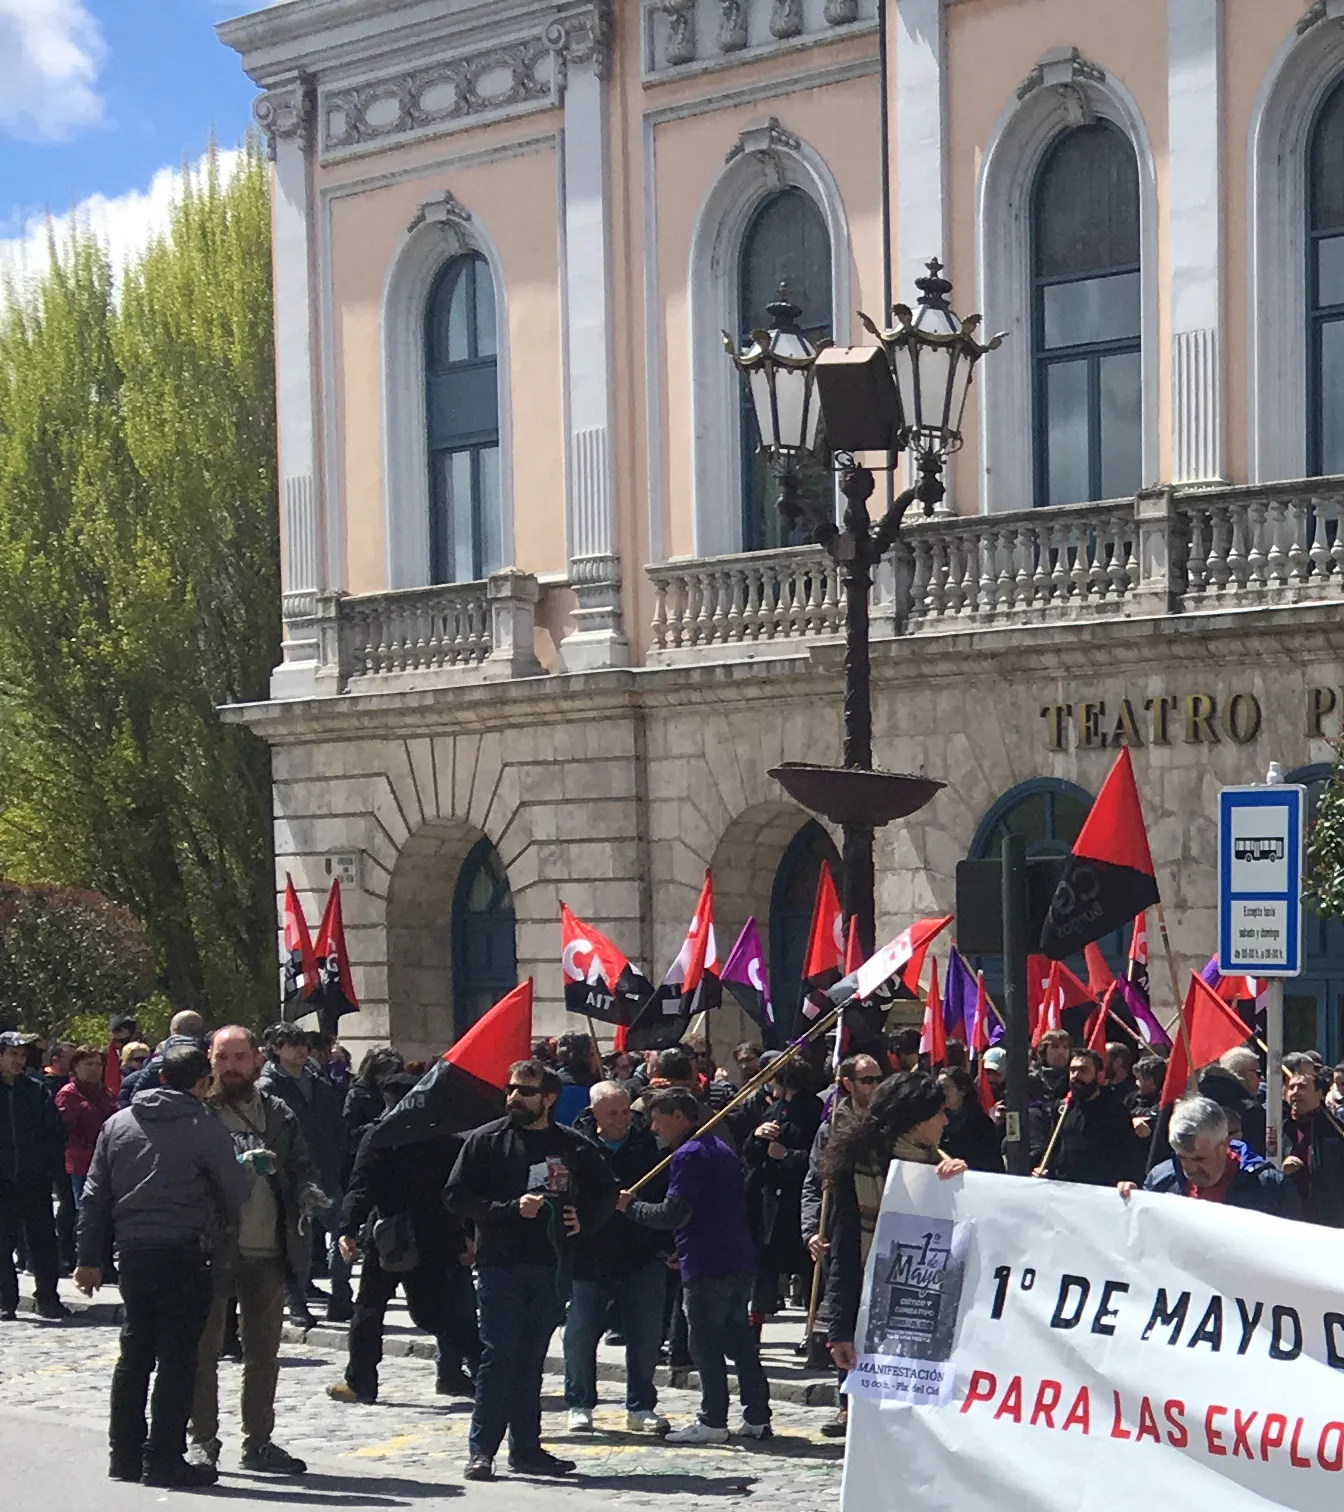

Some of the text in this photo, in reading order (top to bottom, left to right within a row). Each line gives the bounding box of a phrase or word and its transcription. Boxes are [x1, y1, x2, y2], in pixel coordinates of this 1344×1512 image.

[1039, 691, 1264, 753] TEATRO
[585, 991, 615, 1011] AIT
[990, 1265, 1036, 1320] 1º
[1049, 1272, 1130, 1337] DE
[1140, 1287, 1303, 1362] MAYO
[856, 1362, 945, 1382] MANIFESTACIÓN
[959, 1369, 1091, 1436] PARA
[1109, 1388, 1189, 1449] LAS
